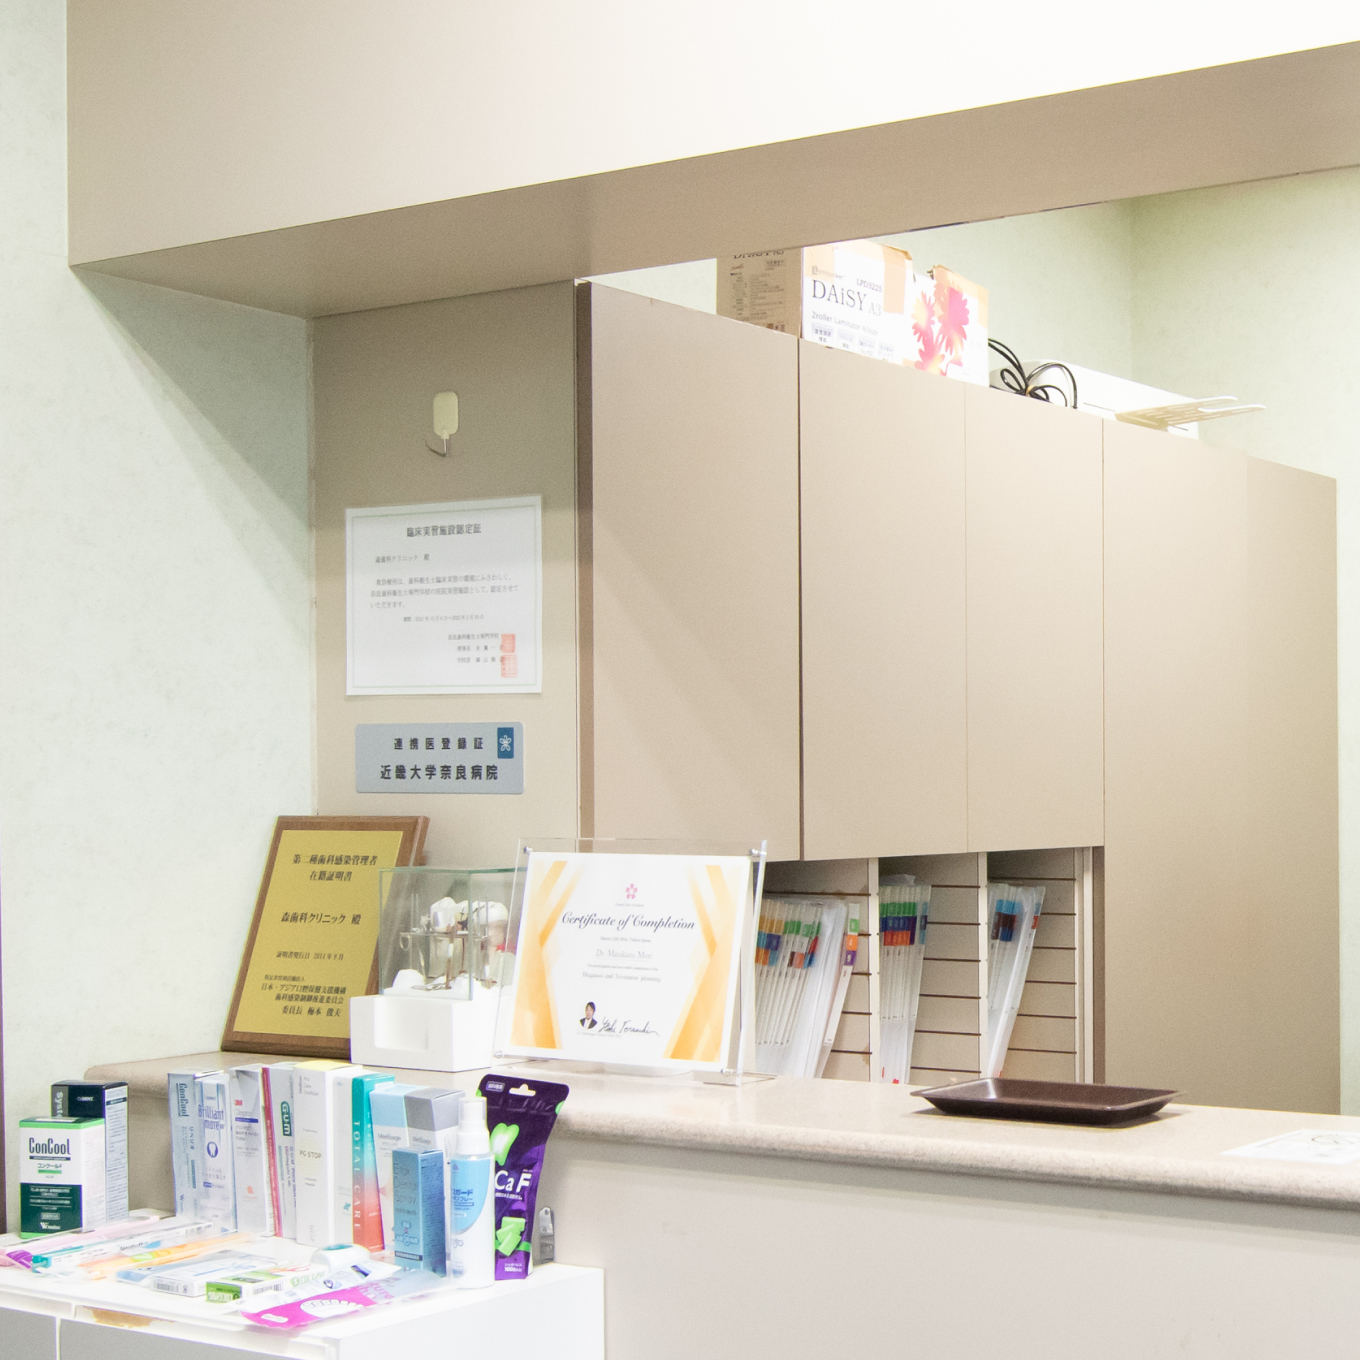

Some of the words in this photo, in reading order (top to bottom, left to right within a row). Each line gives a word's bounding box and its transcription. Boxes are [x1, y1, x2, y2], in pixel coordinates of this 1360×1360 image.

[857, 279, 883, 293] LPD3225
[406, 523, 482, 538] 臨床実習施設認定証
[393, 737, 484, 750] 連携医登録証
[380, 764, 498, 780] 近畿大学奈良病院
[293, 854, 378, 866] 第二種歯科感染管理者
[309, 870, 353, 882] 在籍証明書
[281, 911, 346, 924] 森歯科クリニック
[351, 914, 362, 925] 殿
[562, 911, 616, 929] Certificate
[618, 915, 632, 931] of
[632, 914, 695, 933] Completion
[29, 1137, 71, 1155] ConCool
[353, 1121, 361, 1171] TOTAL
[495, 1170, 514, 1191] Ca
[518, 1173, 532, 1193] F
